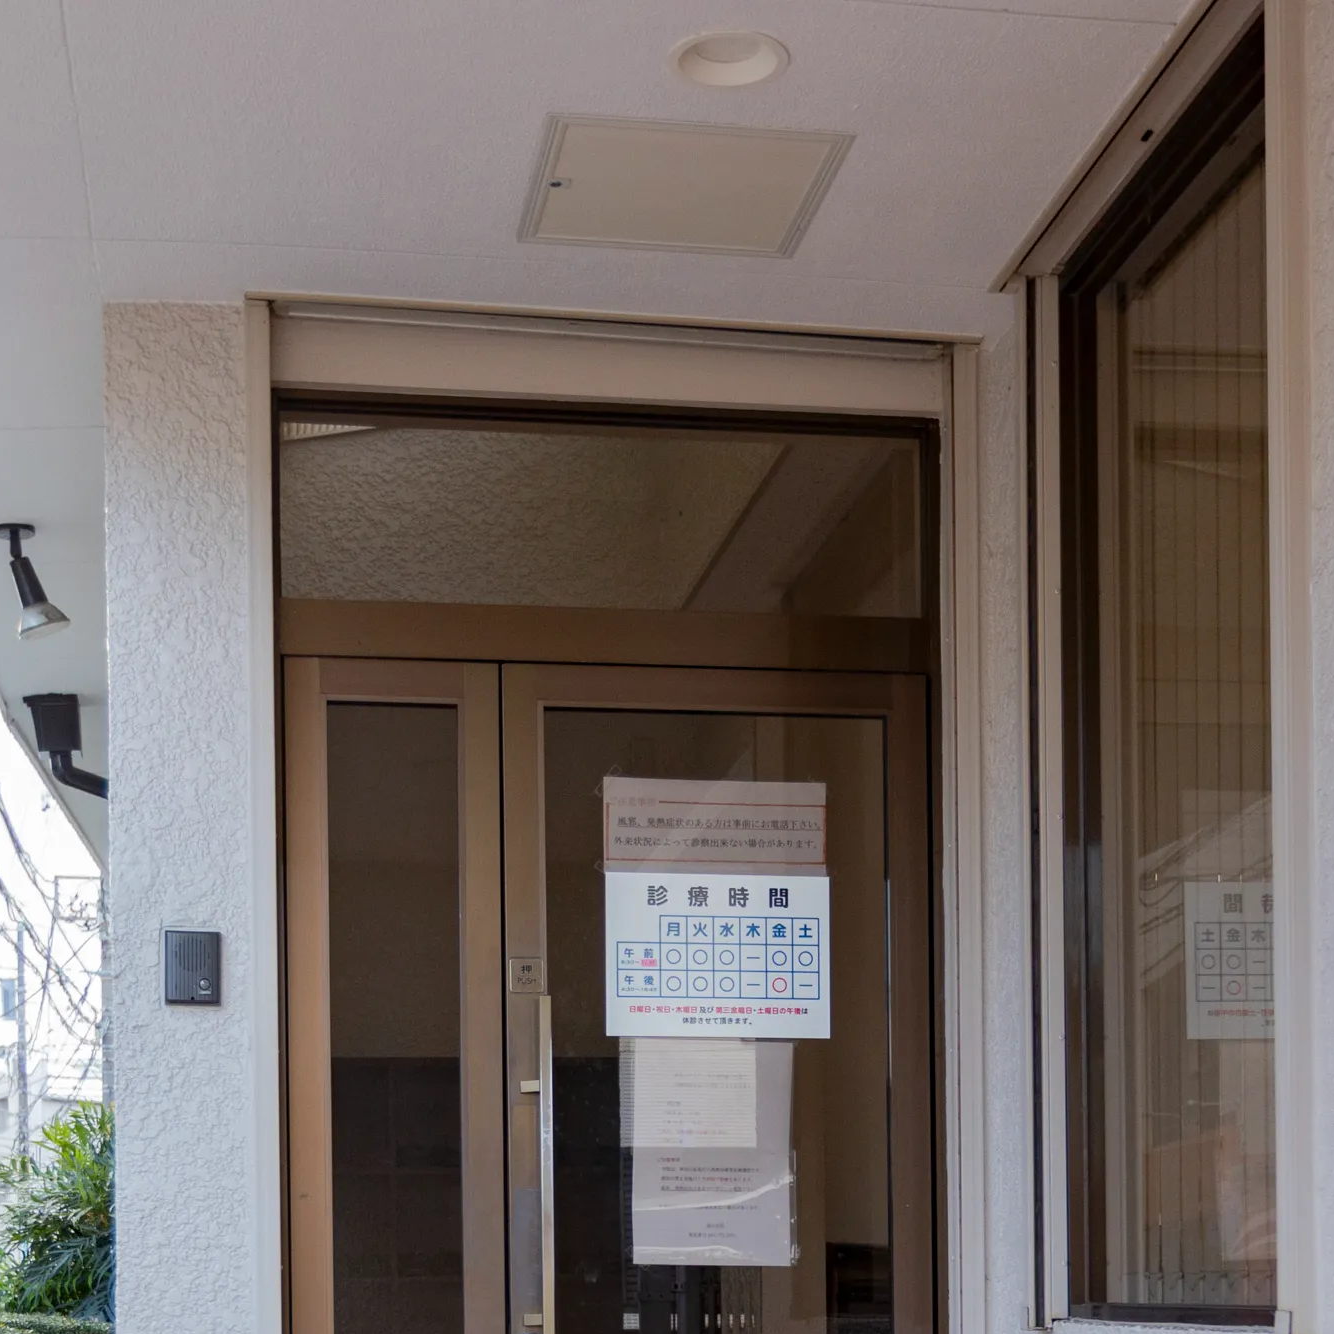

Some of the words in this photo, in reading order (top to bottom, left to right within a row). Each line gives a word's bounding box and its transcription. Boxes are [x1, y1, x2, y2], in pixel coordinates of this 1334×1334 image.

[647, 885, 790, 909] 診療時間
[666, 922, 681, 937] 月
[693, 922, 708, 937] 火
[719, 922, 735, 938] 水
[746, 922, 761, 938] 木
[771, 923, 788, 938] 金
[798, 924, 814, 938] 土
[623, 975, 655, 986] 午後
